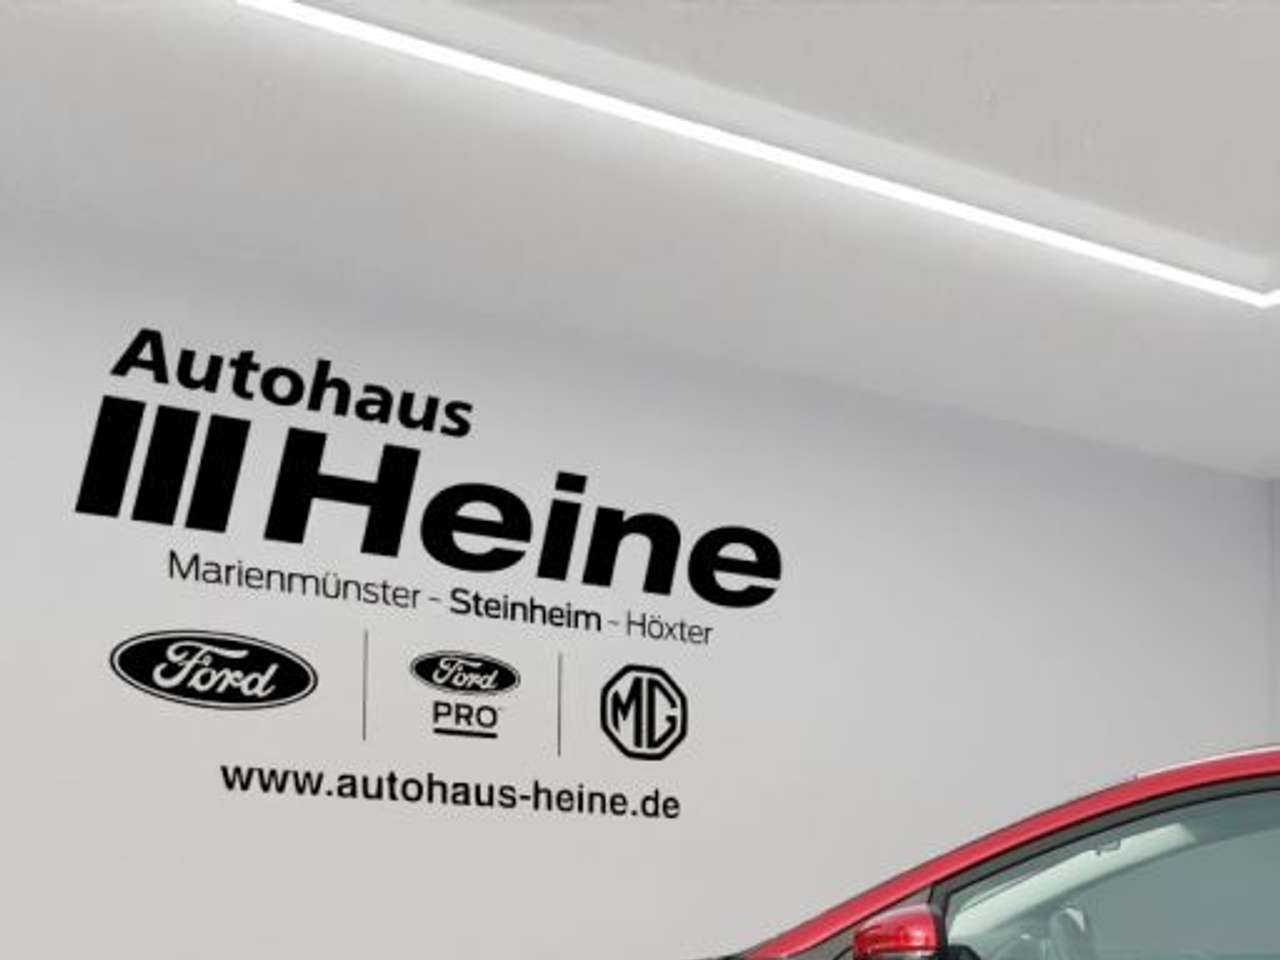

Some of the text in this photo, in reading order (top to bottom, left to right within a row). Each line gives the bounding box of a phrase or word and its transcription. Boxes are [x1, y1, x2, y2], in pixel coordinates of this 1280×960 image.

[111, 328, 473, 438] Autohaus
[264, 427, 782, 609] Heine
[169, 549, 421, 609] Marienmünster
[450, 587, 602, 632] Steinheim
[626, 613, 714, 646] Höxter
[152, 639, 280, 699] Ford
[432, 656, 500, 690] Ford
[433, 700, 498, 729] PRO
[610, 676, 678, 749] MG
[220, 765, 681, 819] www.autohaus-heine.de
